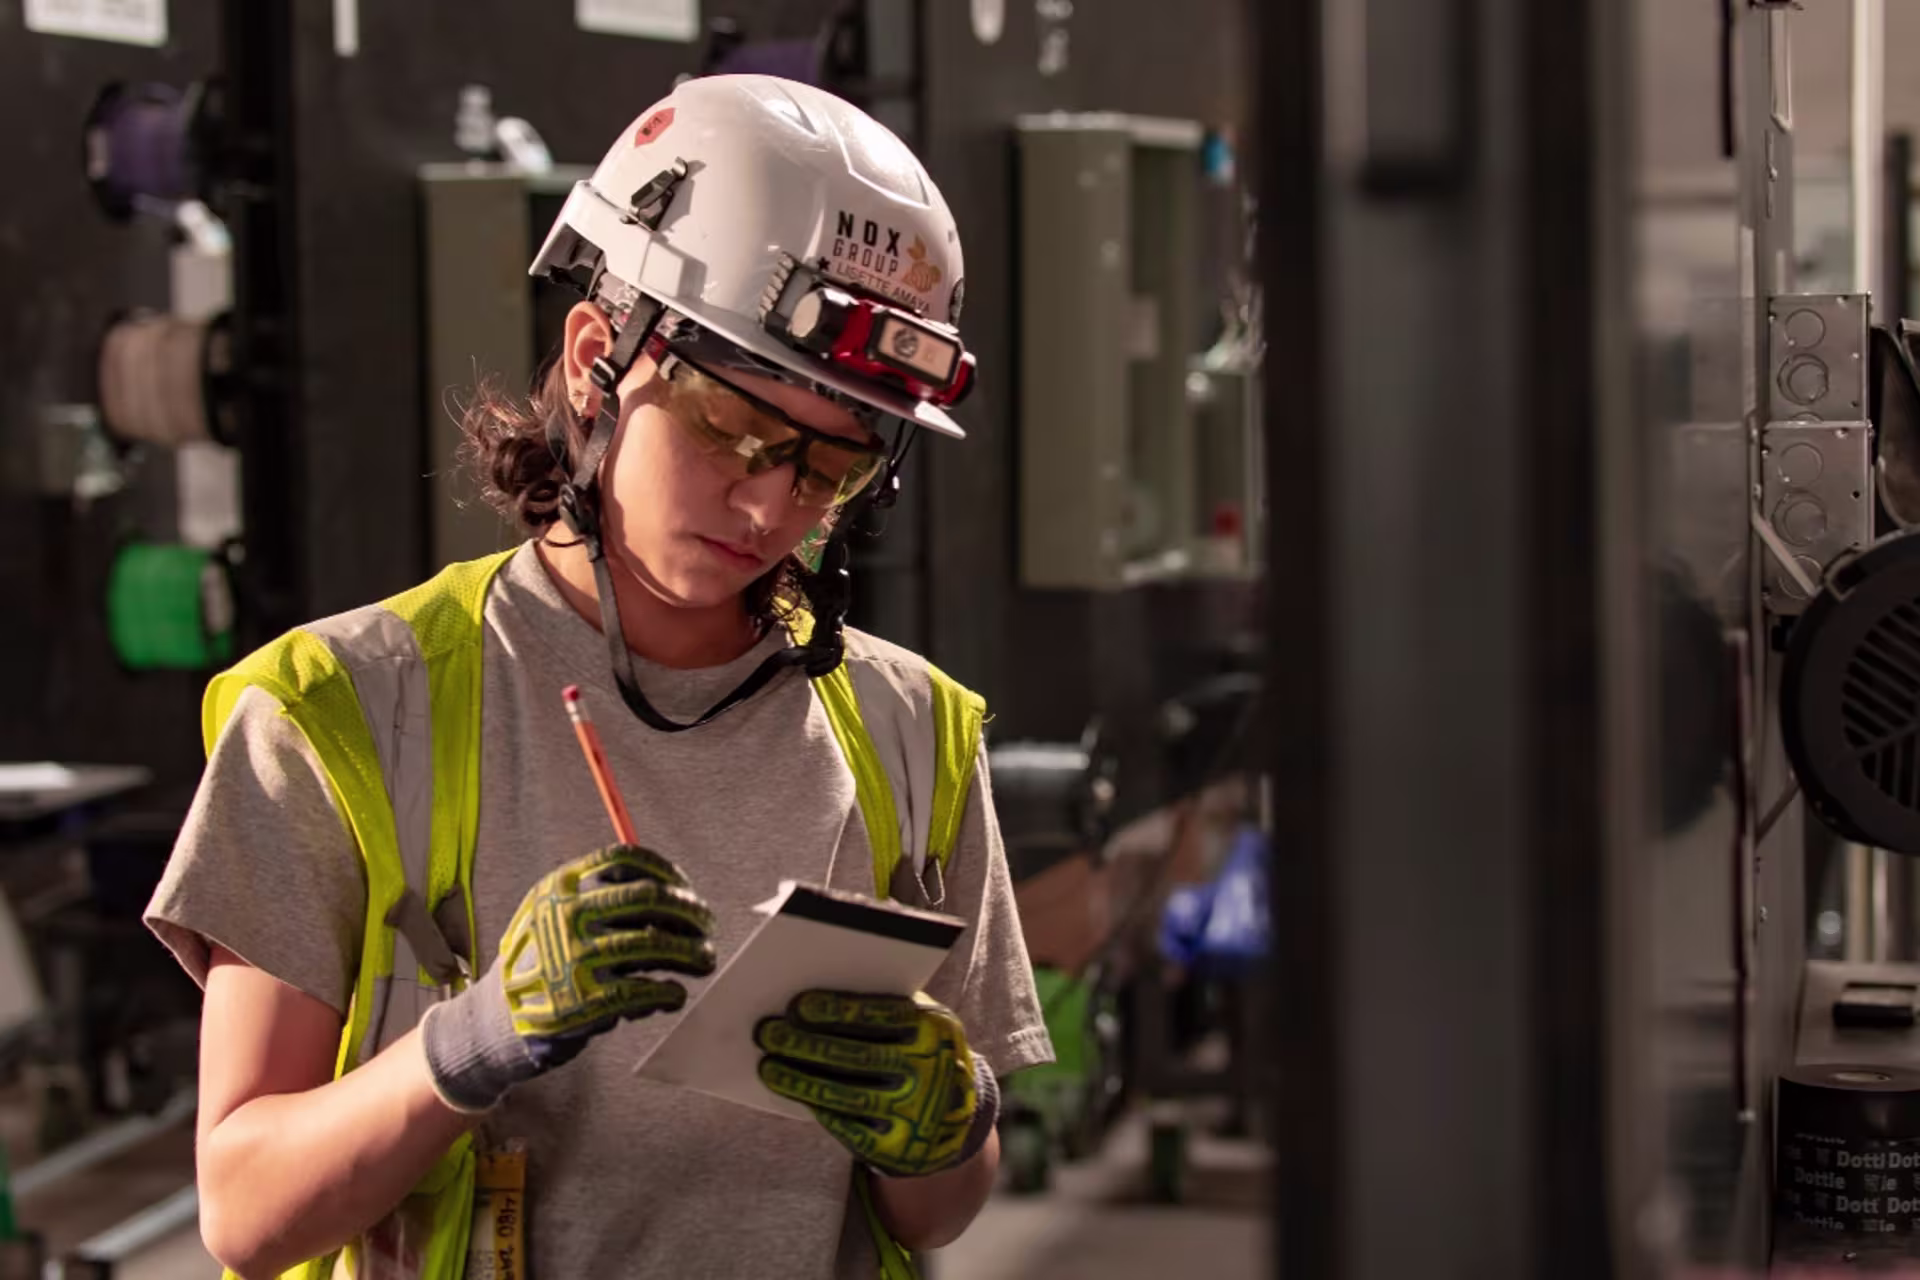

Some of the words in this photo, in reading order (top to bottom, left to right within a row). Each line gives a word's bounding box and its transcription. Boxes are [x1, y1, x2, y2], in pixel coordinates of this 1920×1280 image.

[837, 211, 901, 257] NOX
[833, 239, 899, 277] GROUP
[836, 263, 892, 293] LISETTE
[893, 288, 930, 313] AMAYA
